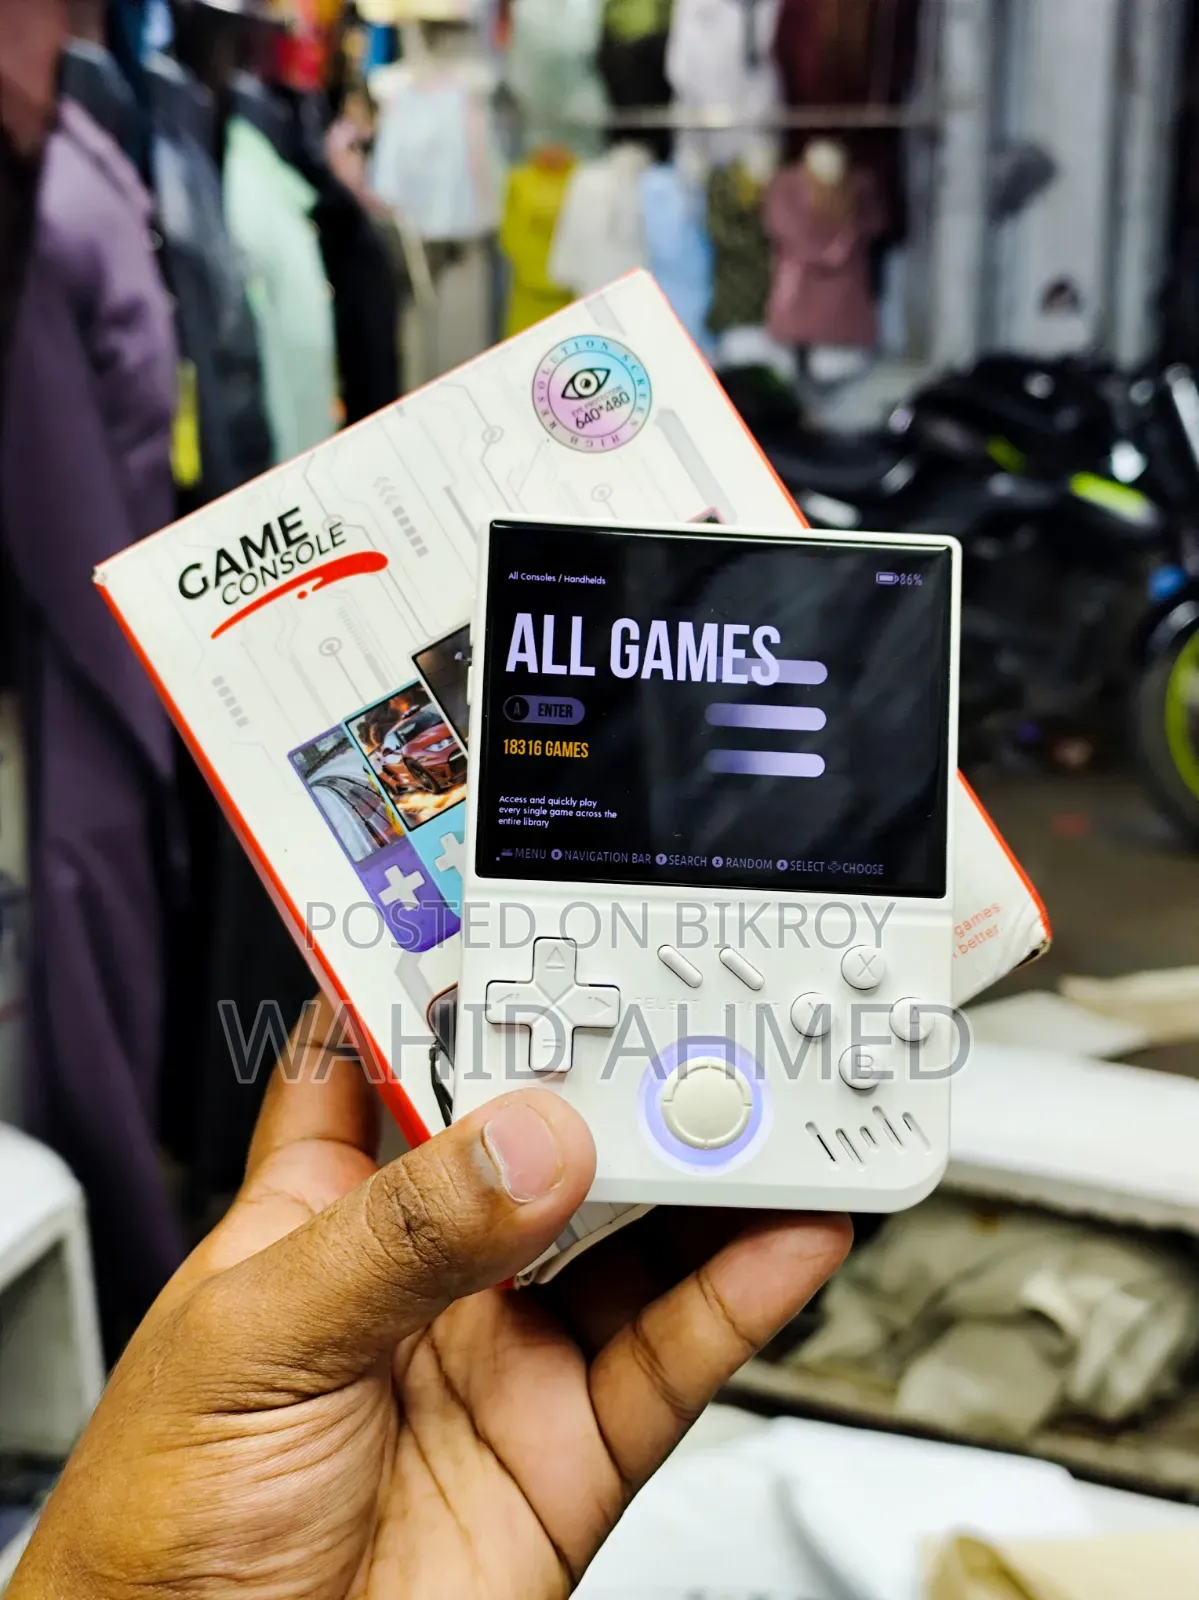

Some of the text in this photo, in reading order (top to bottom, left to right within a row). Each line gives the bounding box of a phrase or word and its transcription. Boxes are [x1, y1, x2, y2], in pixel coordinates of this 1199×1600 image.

[178, 506, 310, 600] GAME
[221, 522, 346, 606] CONSOLE
[508, 571, 519, 581] All
[520, 572, 557, 583] Consoles
[564, 574, 606, 585] Handhelds
[899, 573, 923, 586] 86%
[505, 612, 781, 687] ALL GAMES
[538, 703, 574, 719] ENTER
[503, 738, 589, 759] 18316 GAMES
[498, 805, 618, 819] every single game across the
[499, 795, 598, 808] Access and quickly play
[498, 816, 550, 828] entire library
[515, 848, 547, 860] MENU
[564, 850, 629, 864] NAVIGATION
[631, 853, 652, 864] BAR
[668, 855, 708, 867] SEARCH
[725, 857, 773, 870] RANDOM
[790, 860, 825, 873] SELECT
[842, 862, 885, 876] CHOOSE
[954, 902, 1001, 939] games
[957, 922, 999, 955] better
[857, 953, 877, 980] X
[854, 1053, 875, 1080] B
